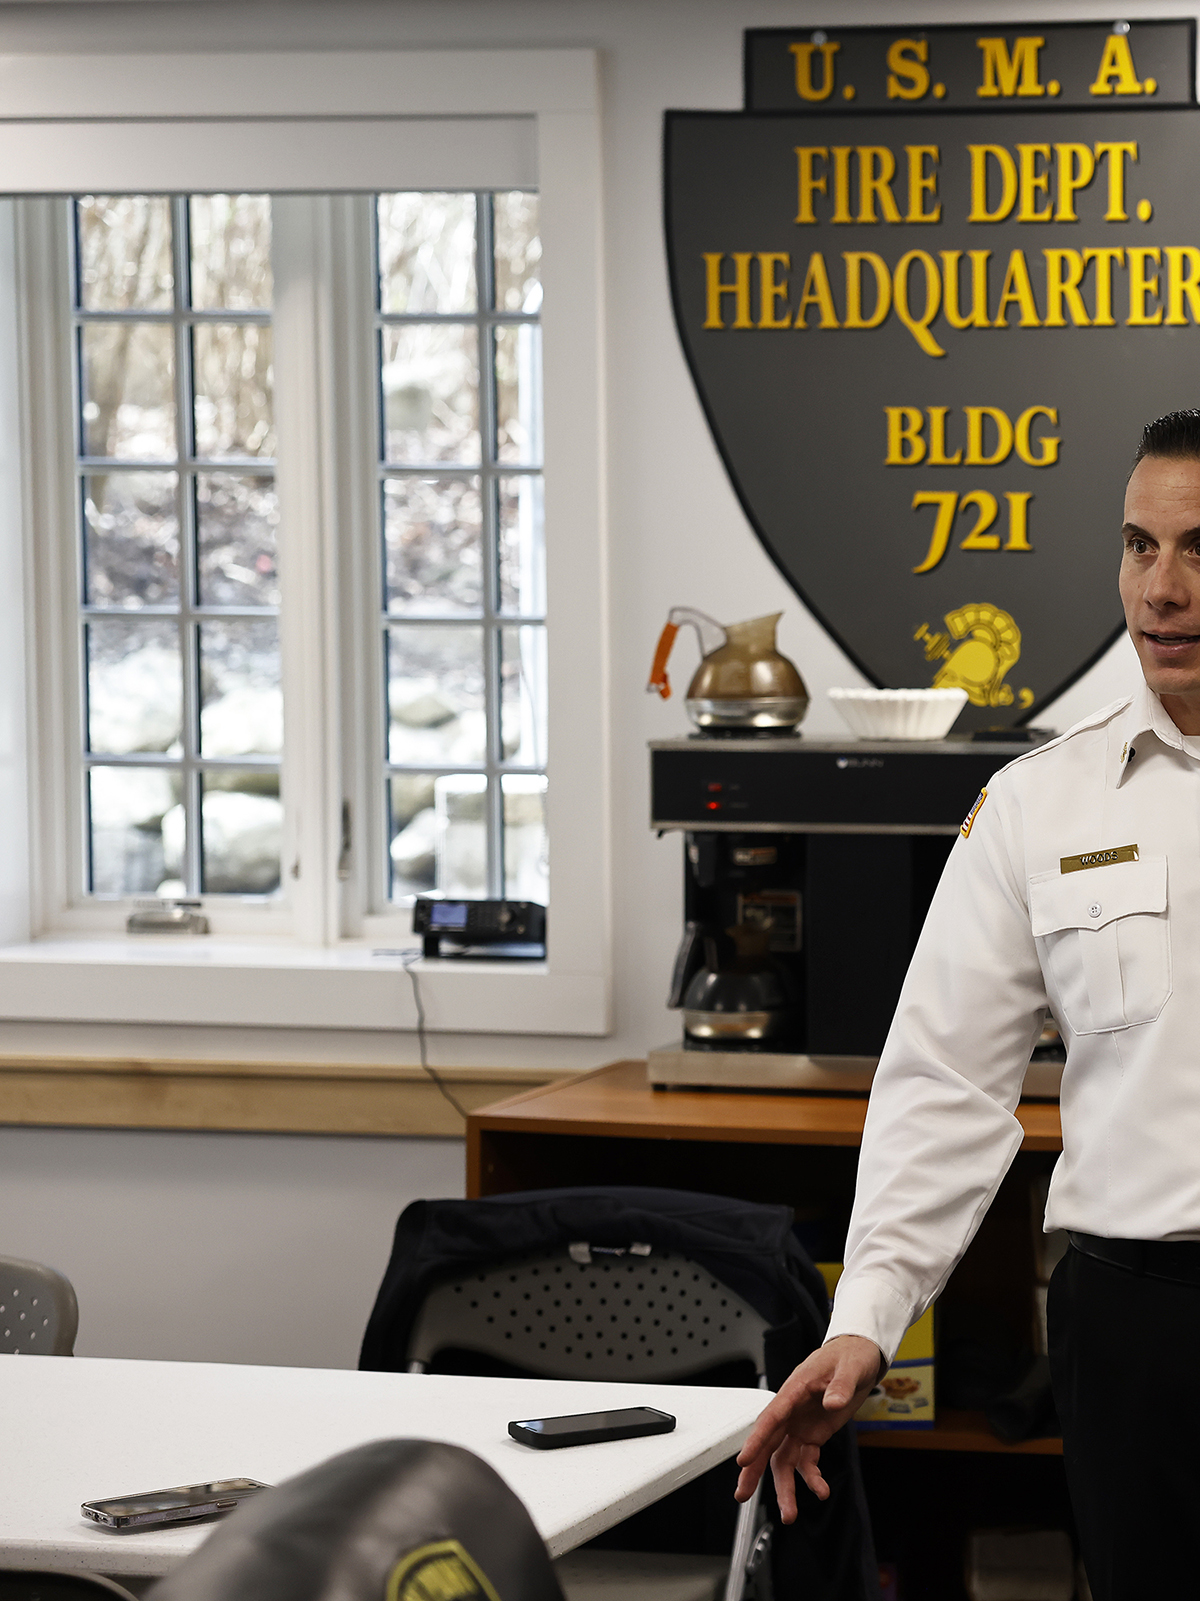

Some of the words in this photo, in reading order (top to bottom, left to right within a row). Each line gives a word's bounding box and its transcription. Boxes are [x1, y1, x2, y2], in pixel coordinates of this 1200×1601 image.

[789, 42, 855, 101] U.
[886, 39, 946, 100] S.
[976, 37, 1061, 98] M.
[1089, 34, 1157, 96] A.
[795, 145, 942, 224] FIRE
[967, 141, 1153, 223] DEPT.
[883, 405, 1062, 467] BLDG
[911, 490, 1033, 574] 721
[1080, 850, 1119, 866] WOODS
